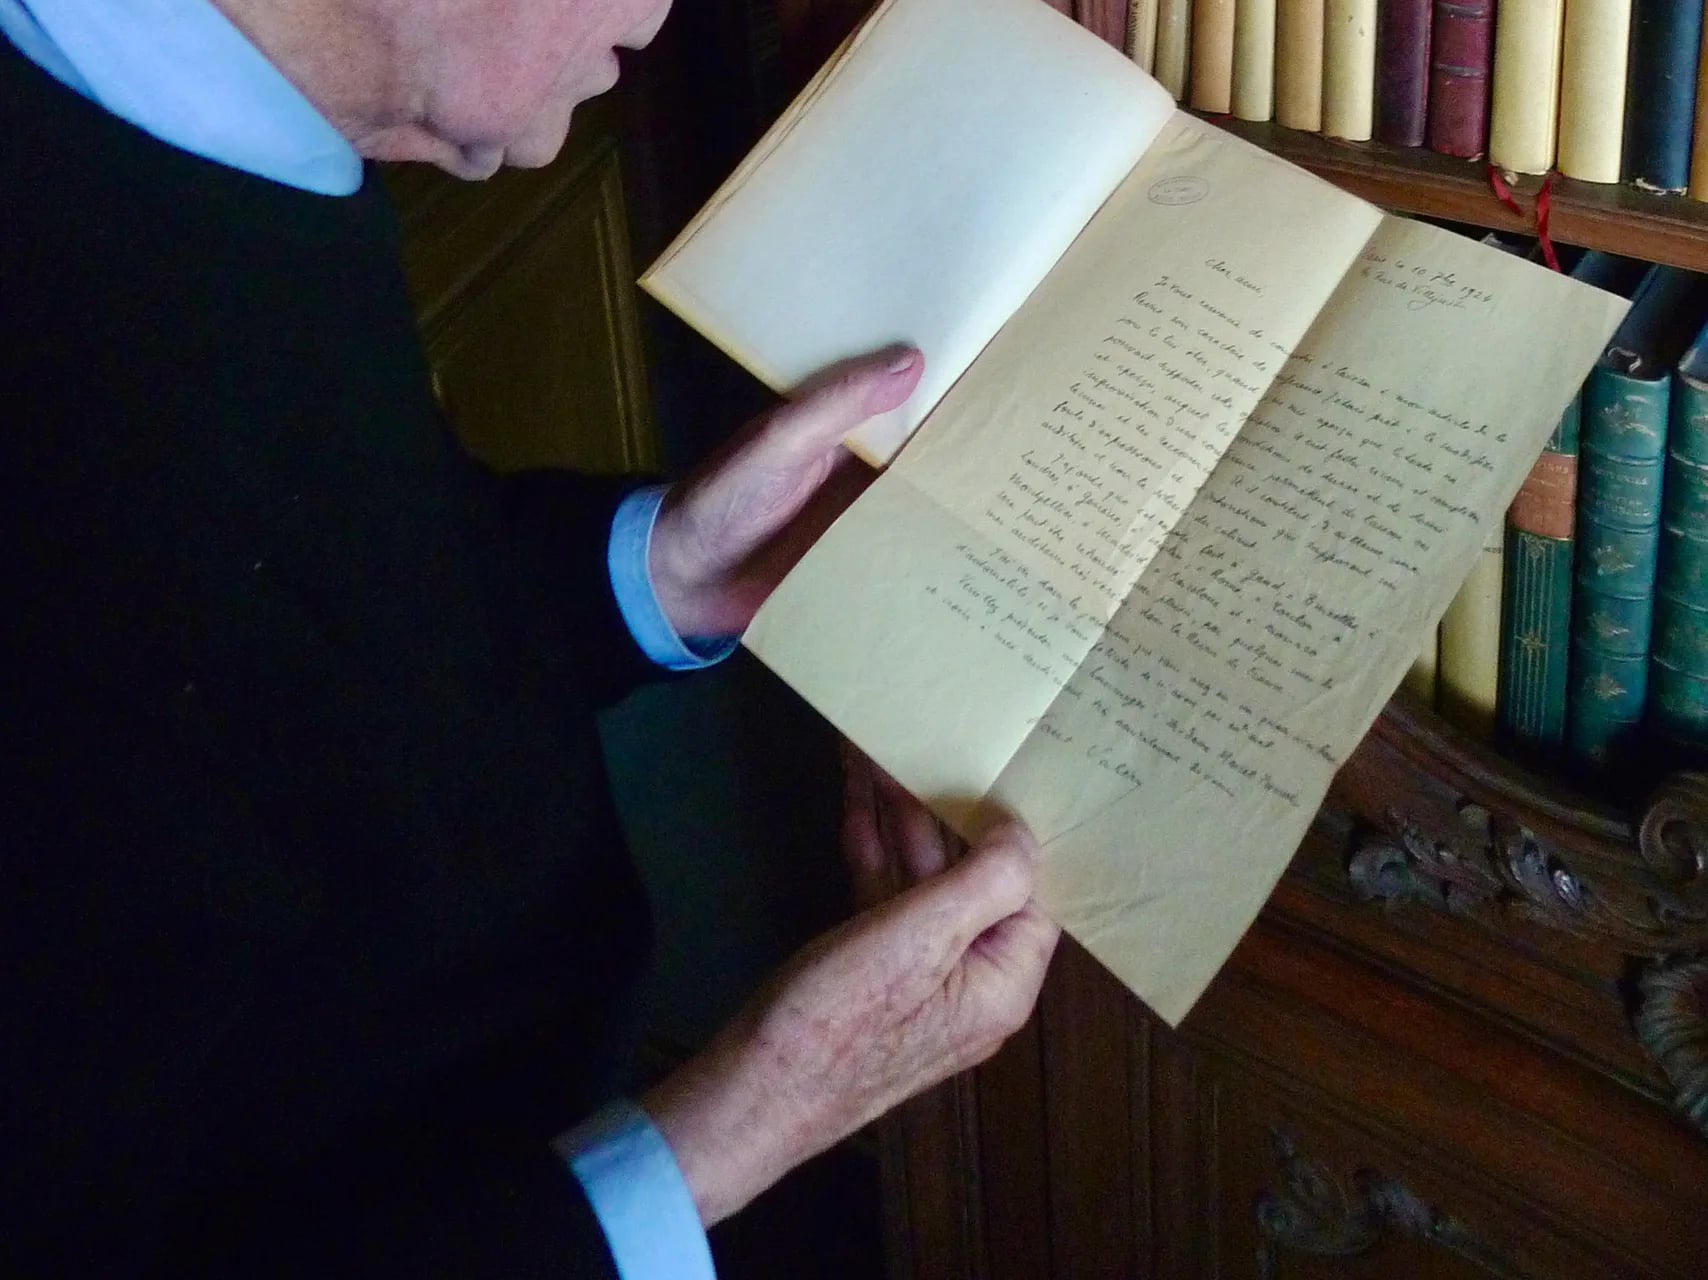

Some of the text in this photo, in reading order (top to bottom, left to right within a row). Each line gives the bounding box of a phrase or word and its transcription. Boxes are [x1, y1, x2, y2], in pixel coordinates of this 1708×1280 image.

[1169, 283, 1193, 300] vous
[1251, 329, 1264, 339] de
[1149, 326, 1160, 339] le
[1214, 369, 1259, 393] quand
[1252, 360, 1267, 372] de
